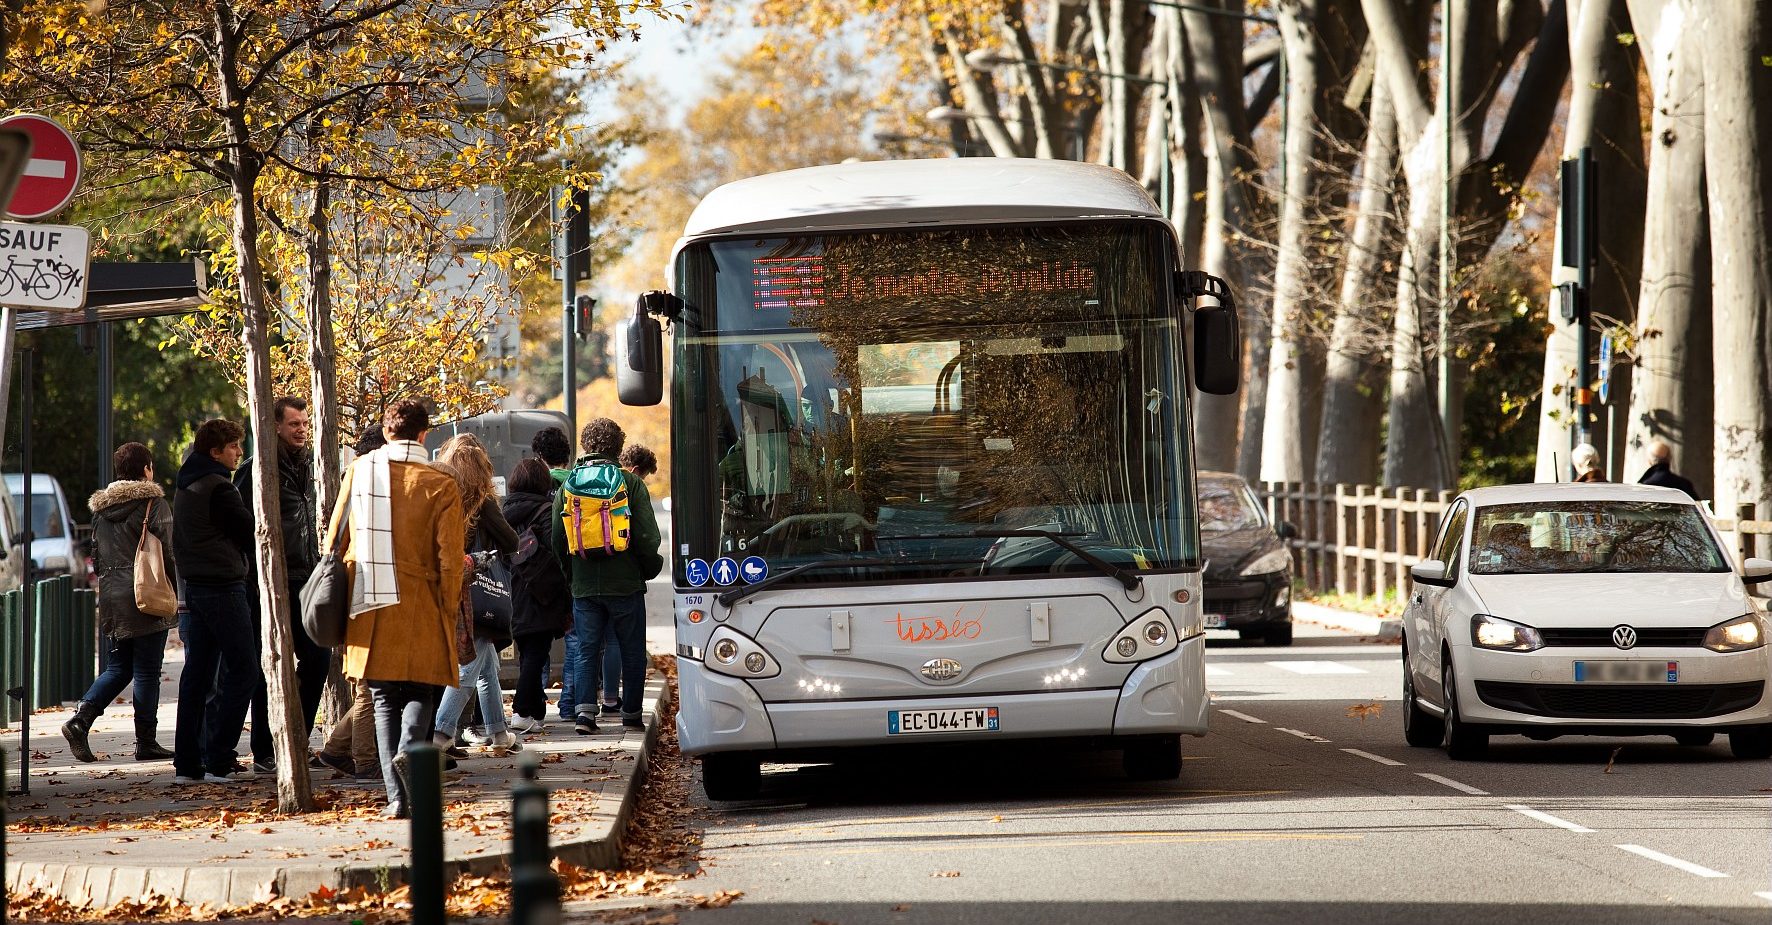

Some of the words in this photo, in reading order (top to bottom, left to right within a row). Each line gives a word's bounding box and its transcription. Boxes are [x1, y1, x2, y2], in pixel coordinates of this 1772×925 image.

[0, 228, 61, 252] SAUF
[832, 264, 865, 298] Je
[1012, 260, 1094, 291] valide
[685, 596, 703, 605] 1670
[884, 602, 988, 643] tisséo
[902, 710, 984, 731] EC-044-FW
[988, 718, 998, 728] 31
